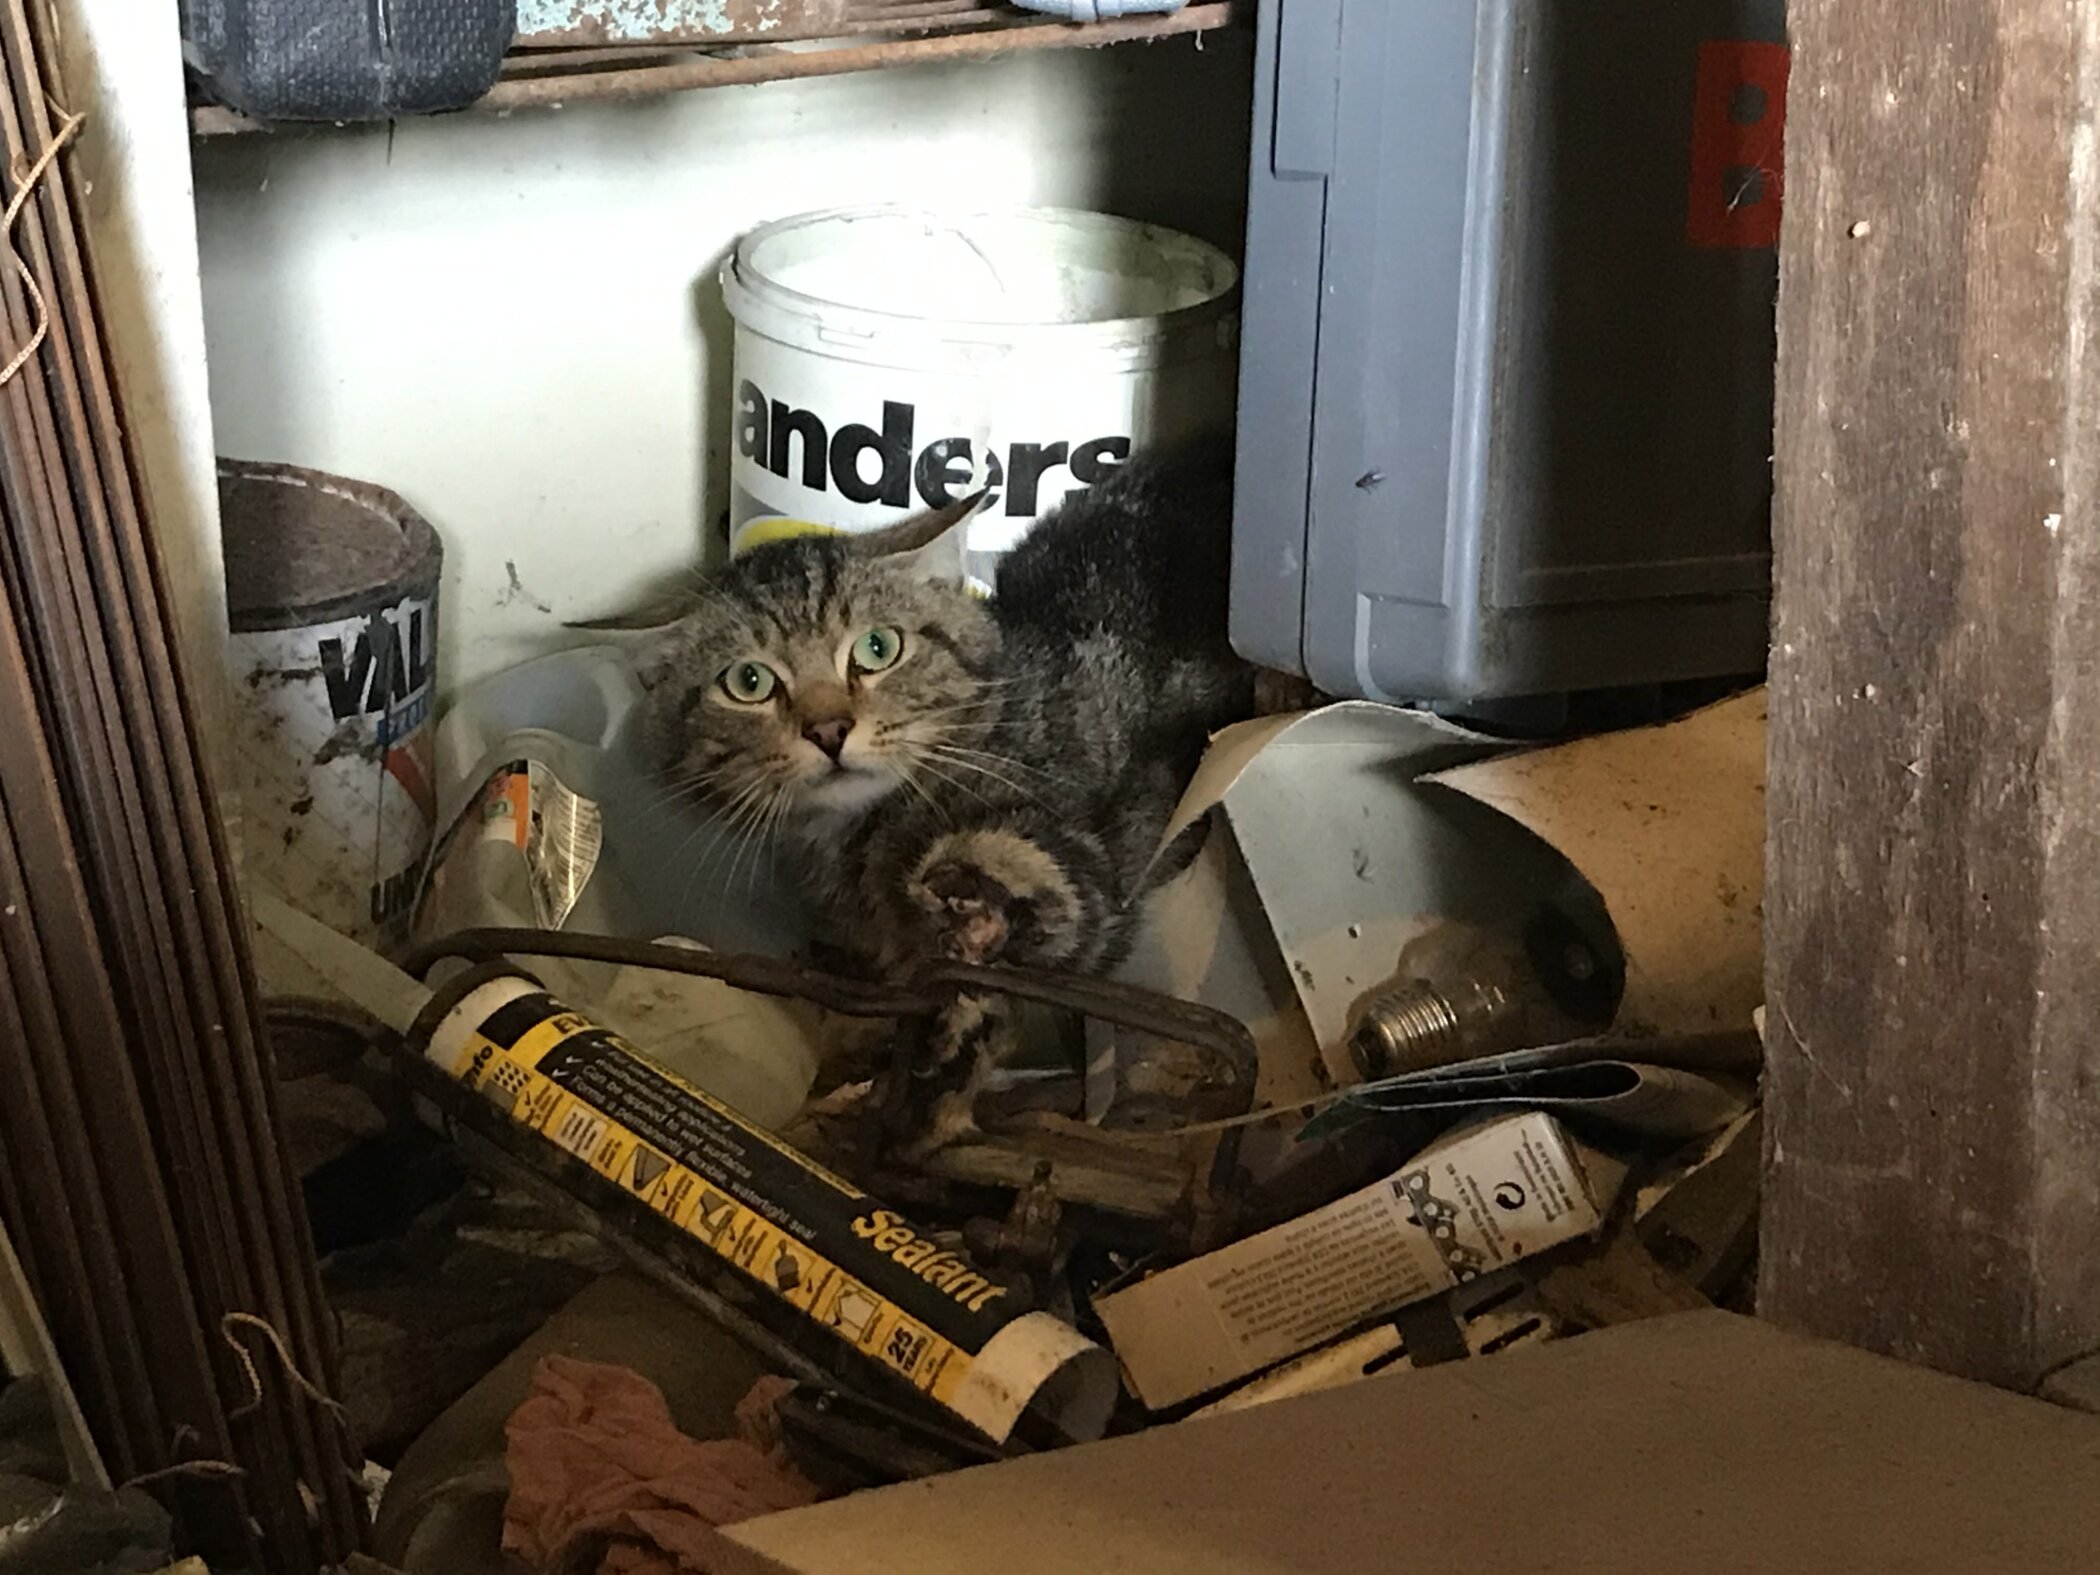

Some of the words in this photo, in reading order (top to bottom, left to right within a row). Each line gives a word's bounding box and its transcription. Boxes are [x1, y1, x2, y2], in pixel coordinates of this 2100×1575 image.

[569, 1074, 608, 1105] Forms
[614, 1105, 686, 1158] permanently
[728, 1178, 790, 1225] watertight
[581, 1062, 607, 1084] Can
[620, 1089, 667, 1126] applied
[679, 1126, 703, 1146] wet
[702, 1140, 753, 1179] surfaces
[850, 1207, 1007, 1313] Sealant
[882, 1325, 917, 1363] 25
